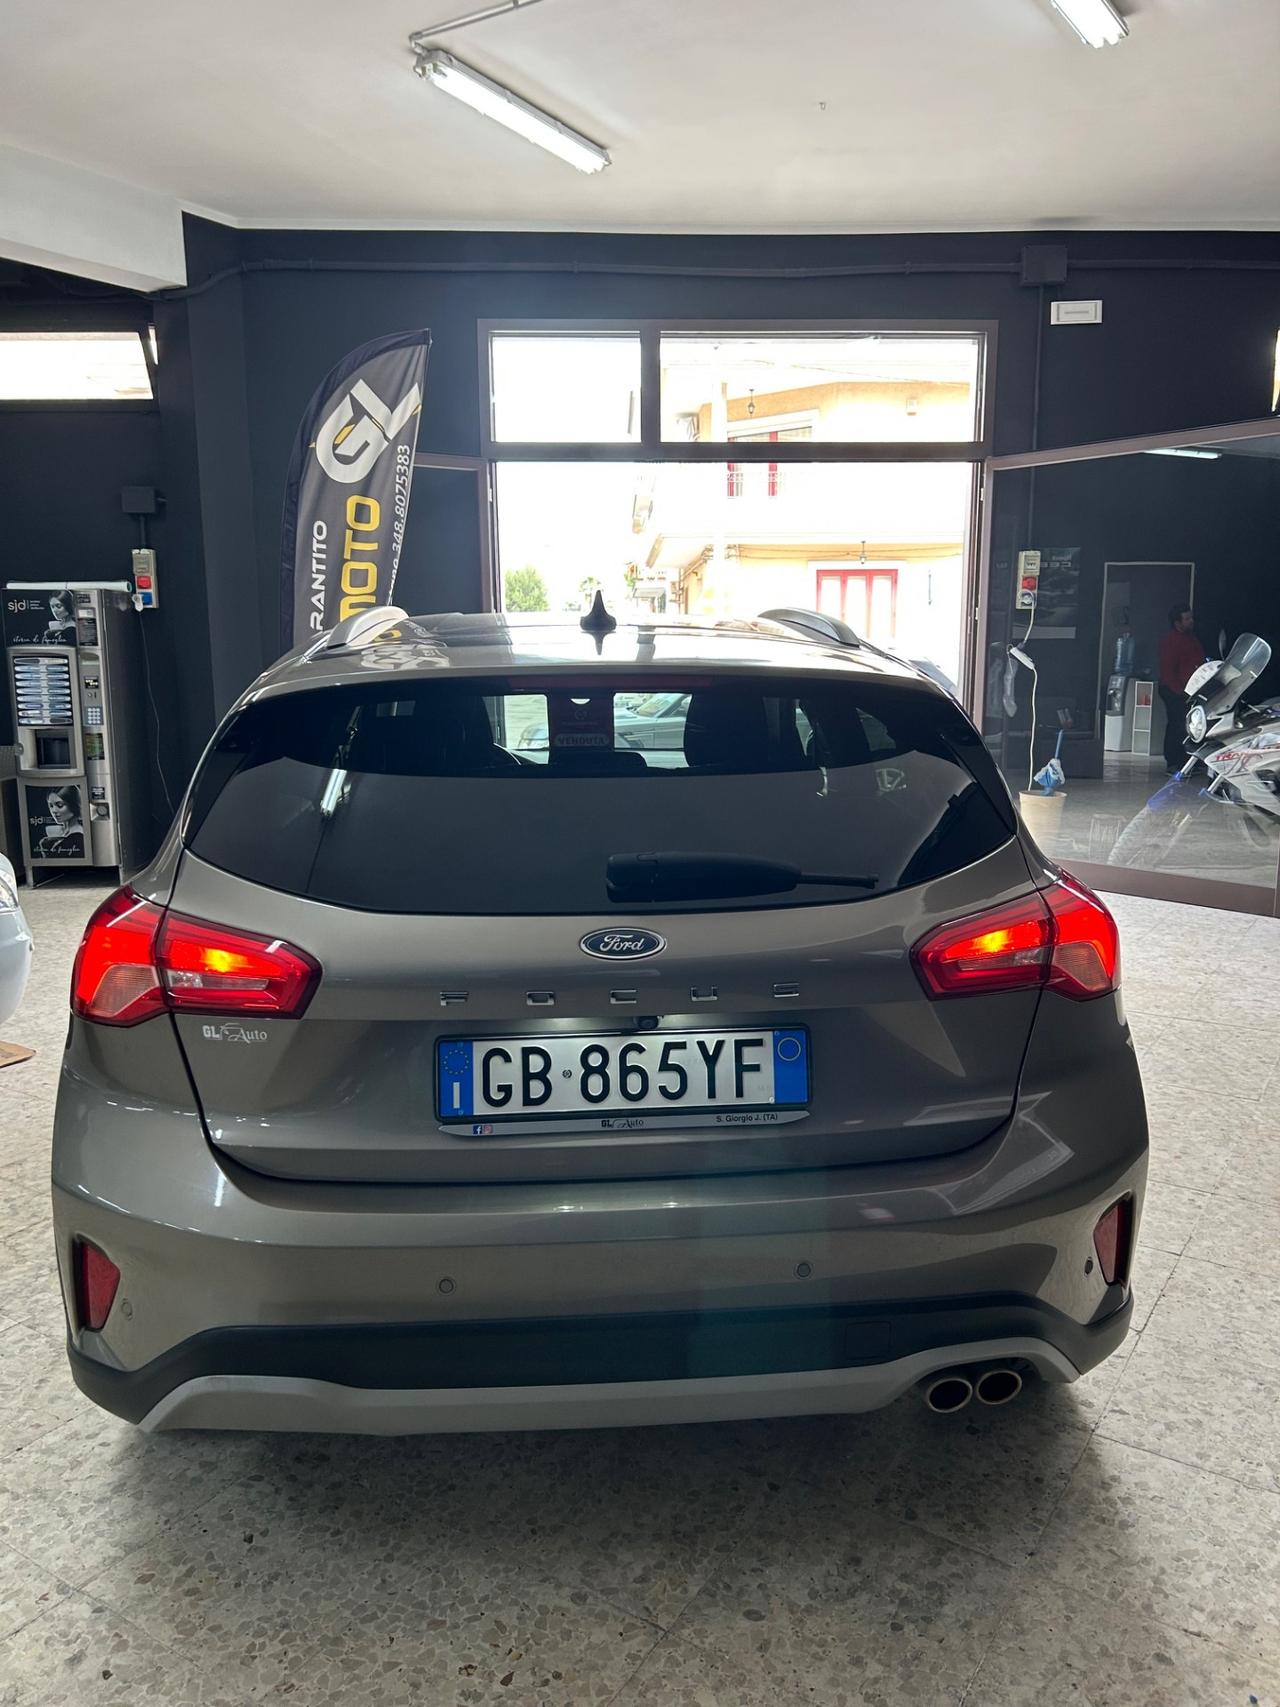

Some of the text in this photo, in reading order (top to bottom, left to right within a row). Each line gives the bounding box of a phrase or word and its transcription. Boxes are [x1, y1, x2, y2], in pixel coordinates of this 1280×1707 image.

[7, 599, 26, 613] sjd
[599, 933, 645, 952] Ford
[439, 983, 800, 1007] FOCUS
[202, 1025, 268, 1043] GL Auto
[482, 1037, 764, 1107] GB 865YF
[725, 1114, 753, 1123] Giorgio
[762, 1113, 778, 1121] (TA)
